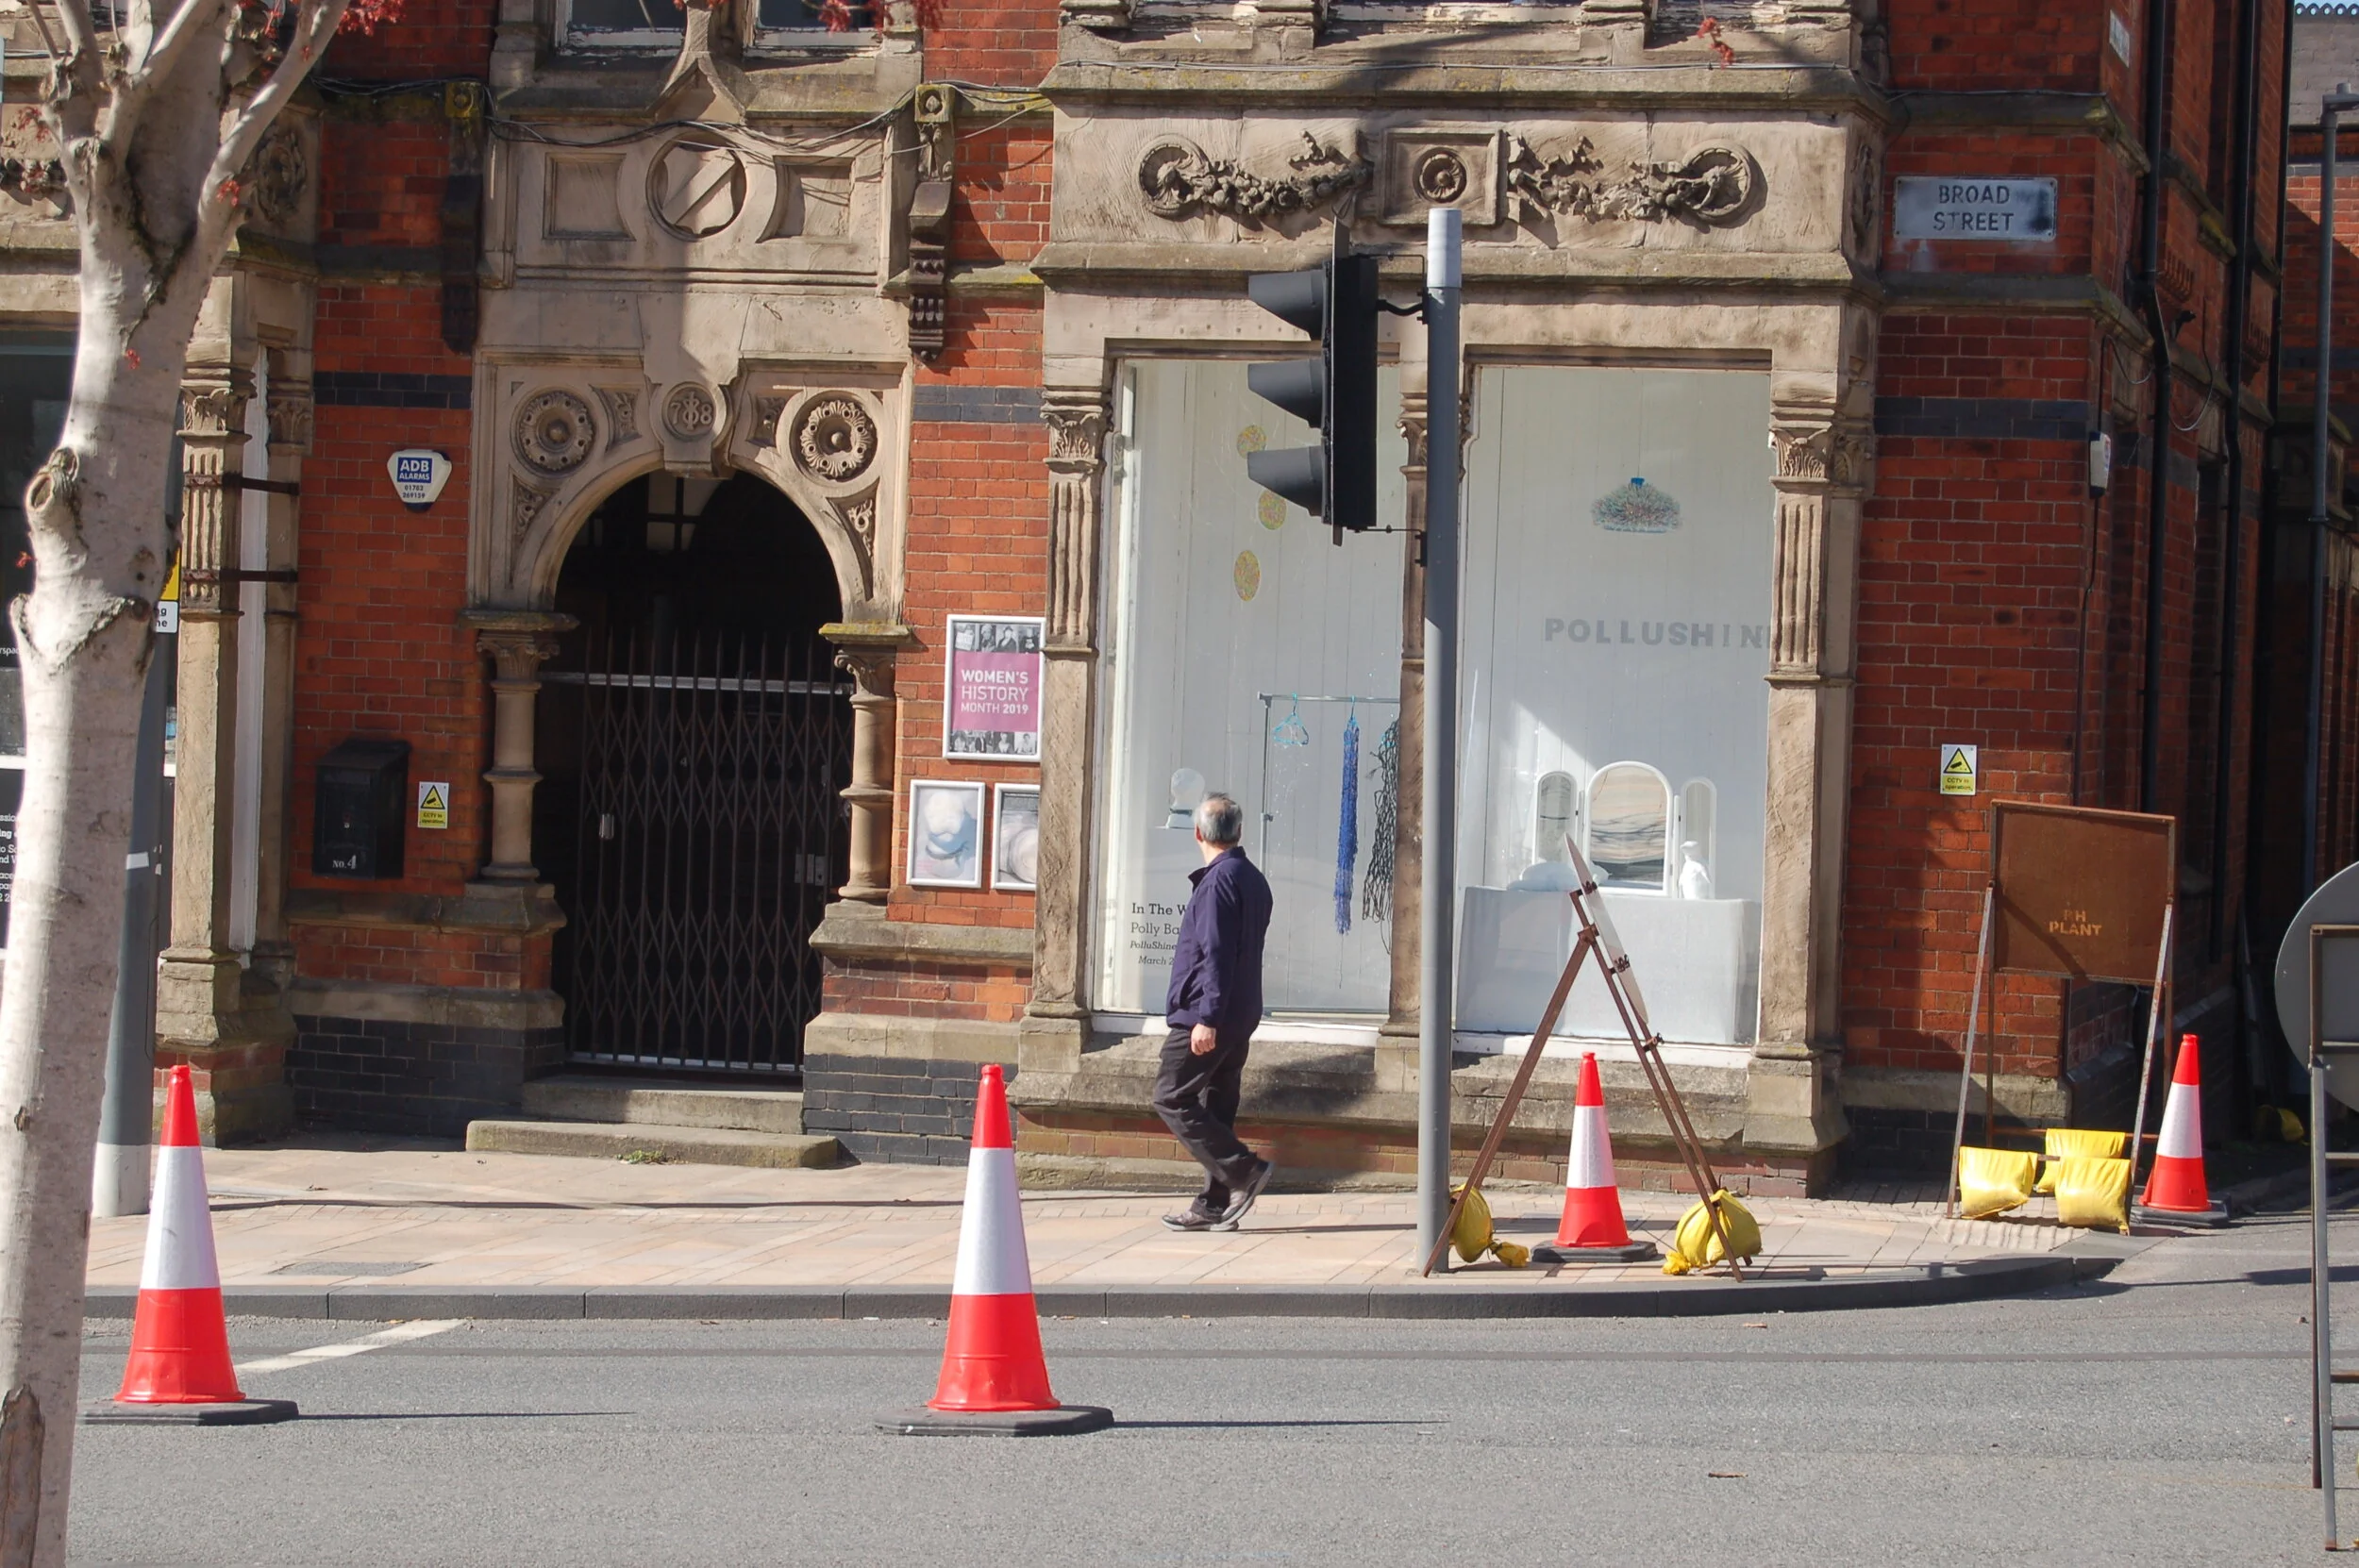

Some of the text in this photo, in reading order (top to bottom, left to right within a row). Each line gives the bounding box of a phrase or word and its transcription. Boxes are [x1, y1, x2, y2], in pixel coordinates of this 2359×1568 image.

[1938, 184, 2011, 205] BROAD
[1932, 210, 2015, 232] STREET
[399, 459, 430, 473] ADB
[399, 472, 430, 480] ALARMS
[961, 669, 1029, 684] WOMEN'S
[961, 686, 1029, 702] HISTORY
[961, 702, 1029, 714] MONTH 2019
[1131, 903, 1145, 914] In
[1148, 903, 1173, 915] The
[1130, 922, 1161, 937] Polly
[2049, 921, 2102, 936] PLANT
[1138, 955, 1166, 965] March
